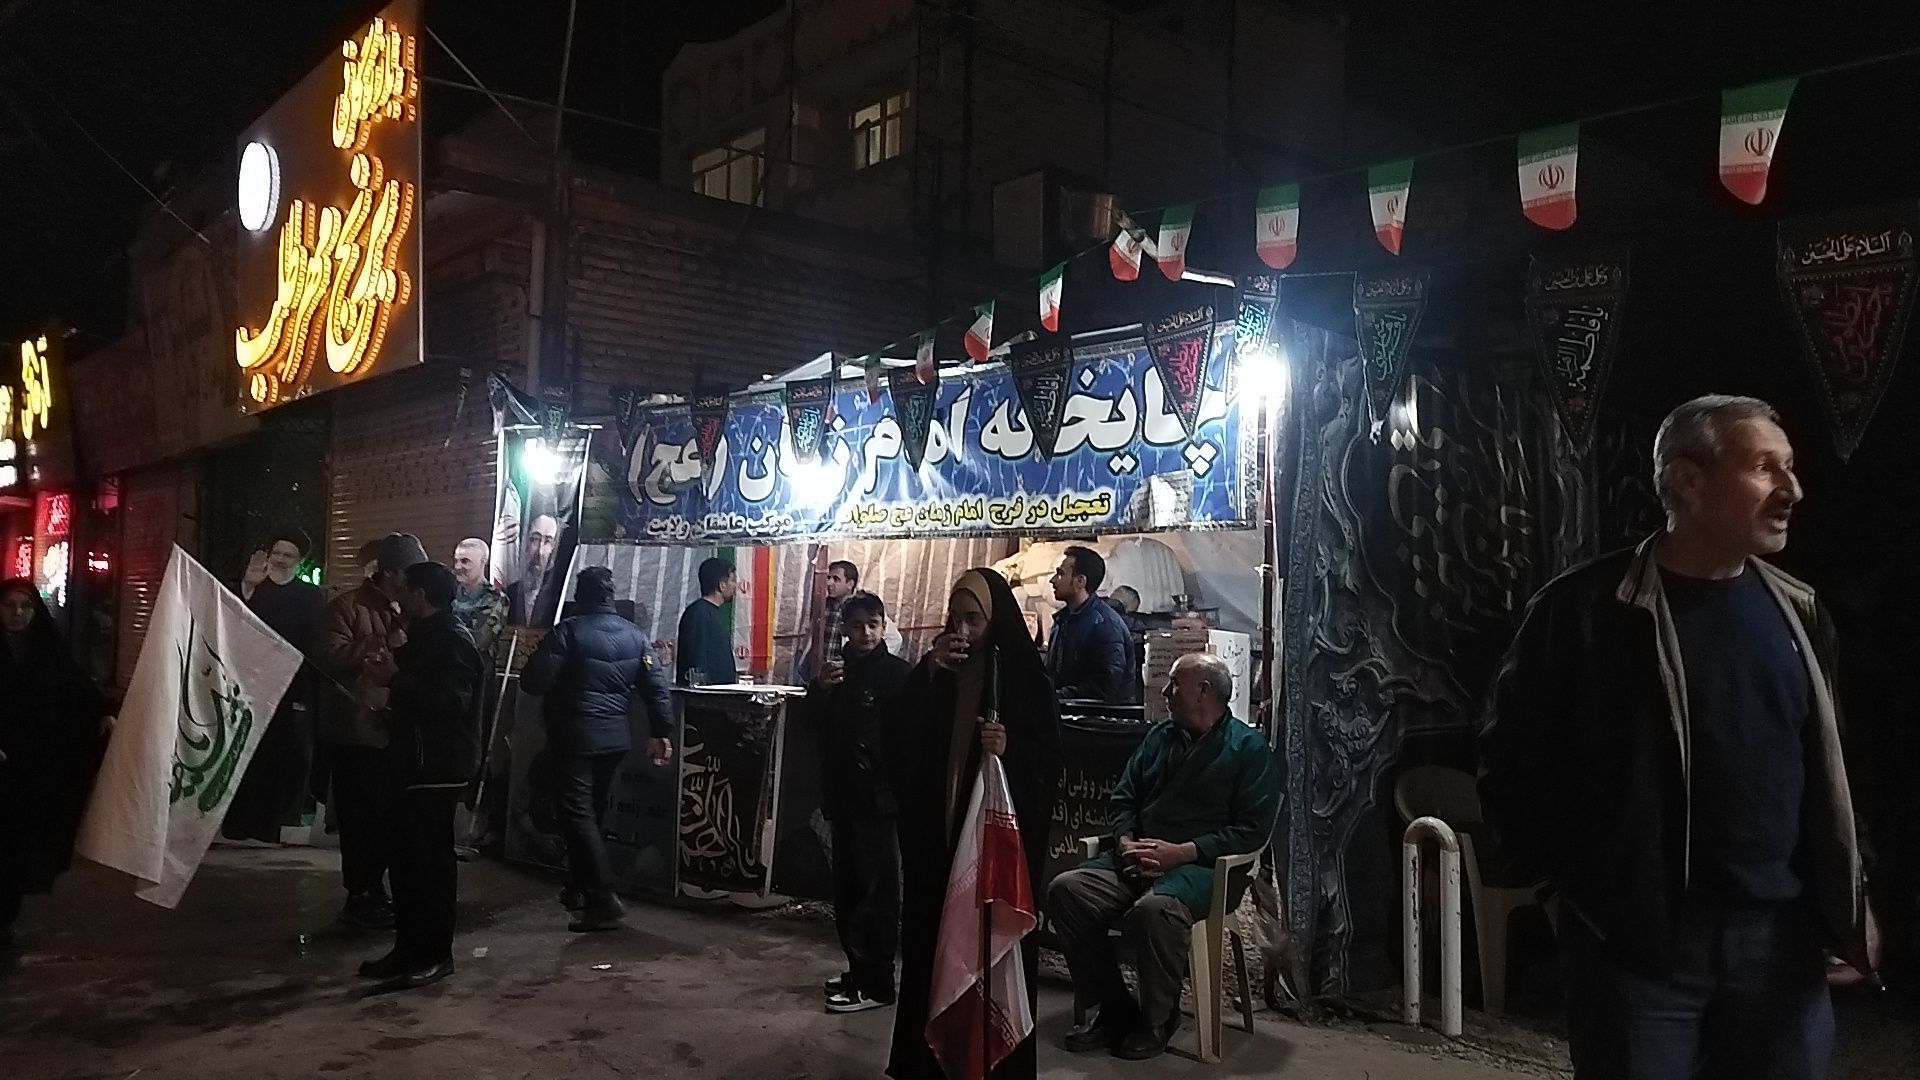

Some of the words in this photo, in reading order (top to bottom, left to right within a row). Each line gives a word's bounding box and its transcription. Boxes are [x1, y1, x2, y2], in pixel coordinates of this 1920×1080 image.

[980, 364, 1232, 478] چایخنه
[863, 386, 973, 494] امم
[914, 501, 953, 528] زمان
[953, 499, 984, 527] امام
[988, 495, 1024, 525] فرج
[1025, 499, 1049, 525] در
[1050, 493, 1111, 523] تعجیل
[1084, 806, 1115, 827] امنه
